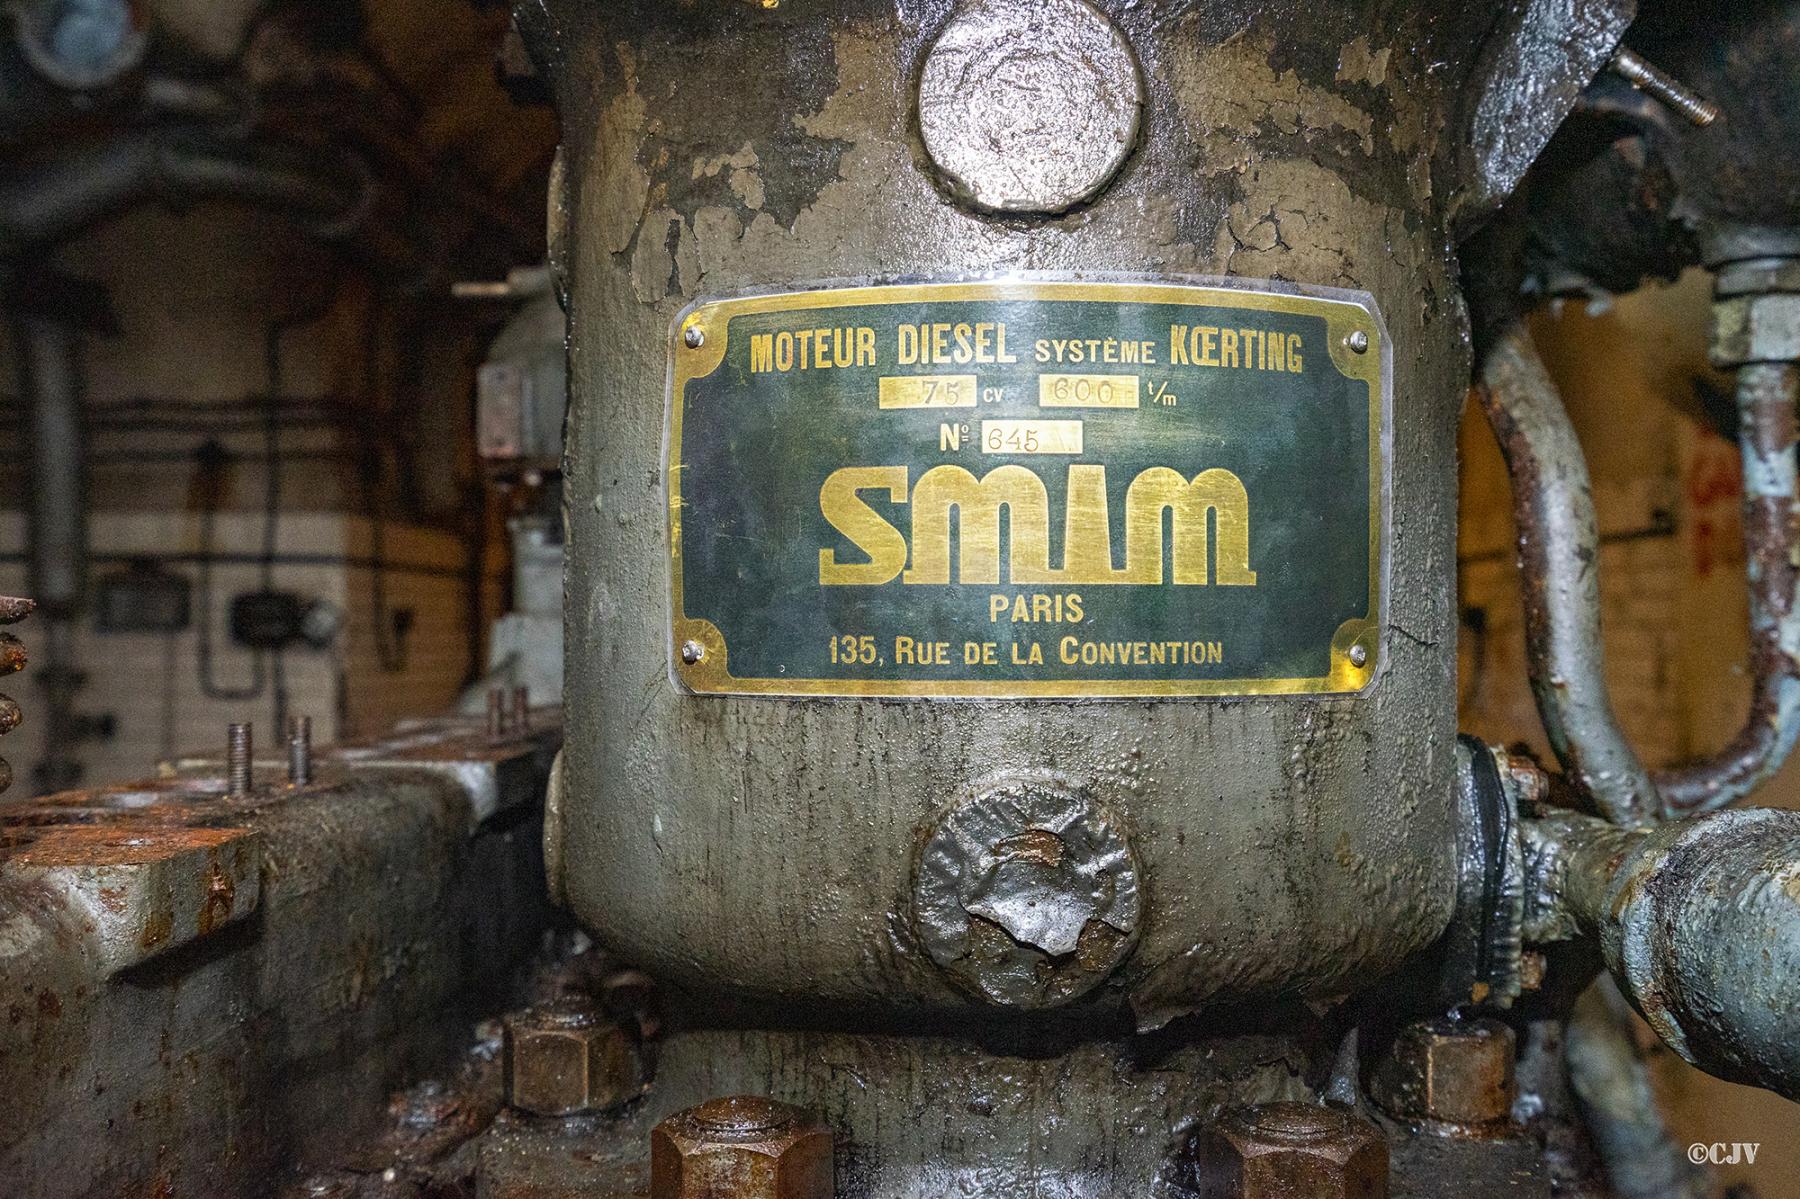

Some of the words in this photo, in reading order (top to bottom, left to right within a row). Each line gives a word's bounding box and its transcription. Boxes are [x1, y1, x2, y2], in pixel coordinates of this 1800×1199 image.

[750, 327, 876, 373] MOTEUR
[898, 323, 1017, 365] DIESEL
[1035, 337, 1156, 364] SYSTÈME
[1170, 324, 1303, 373] KŒRTING
[921, 380, 960, 406] 75
[1053, 377, 1114, 404] 600
[988, 427, 1039, 452] 645
[990, 593, 1085, 624] PARIS
[828, 635, 885, 667] 135,
[895, 636, 948, 666] RUE
[964, 641, 998, 666] DE
[1011, 641, 1044, 666] LA
[1060, 636, 1223, 666] CONVENTION
